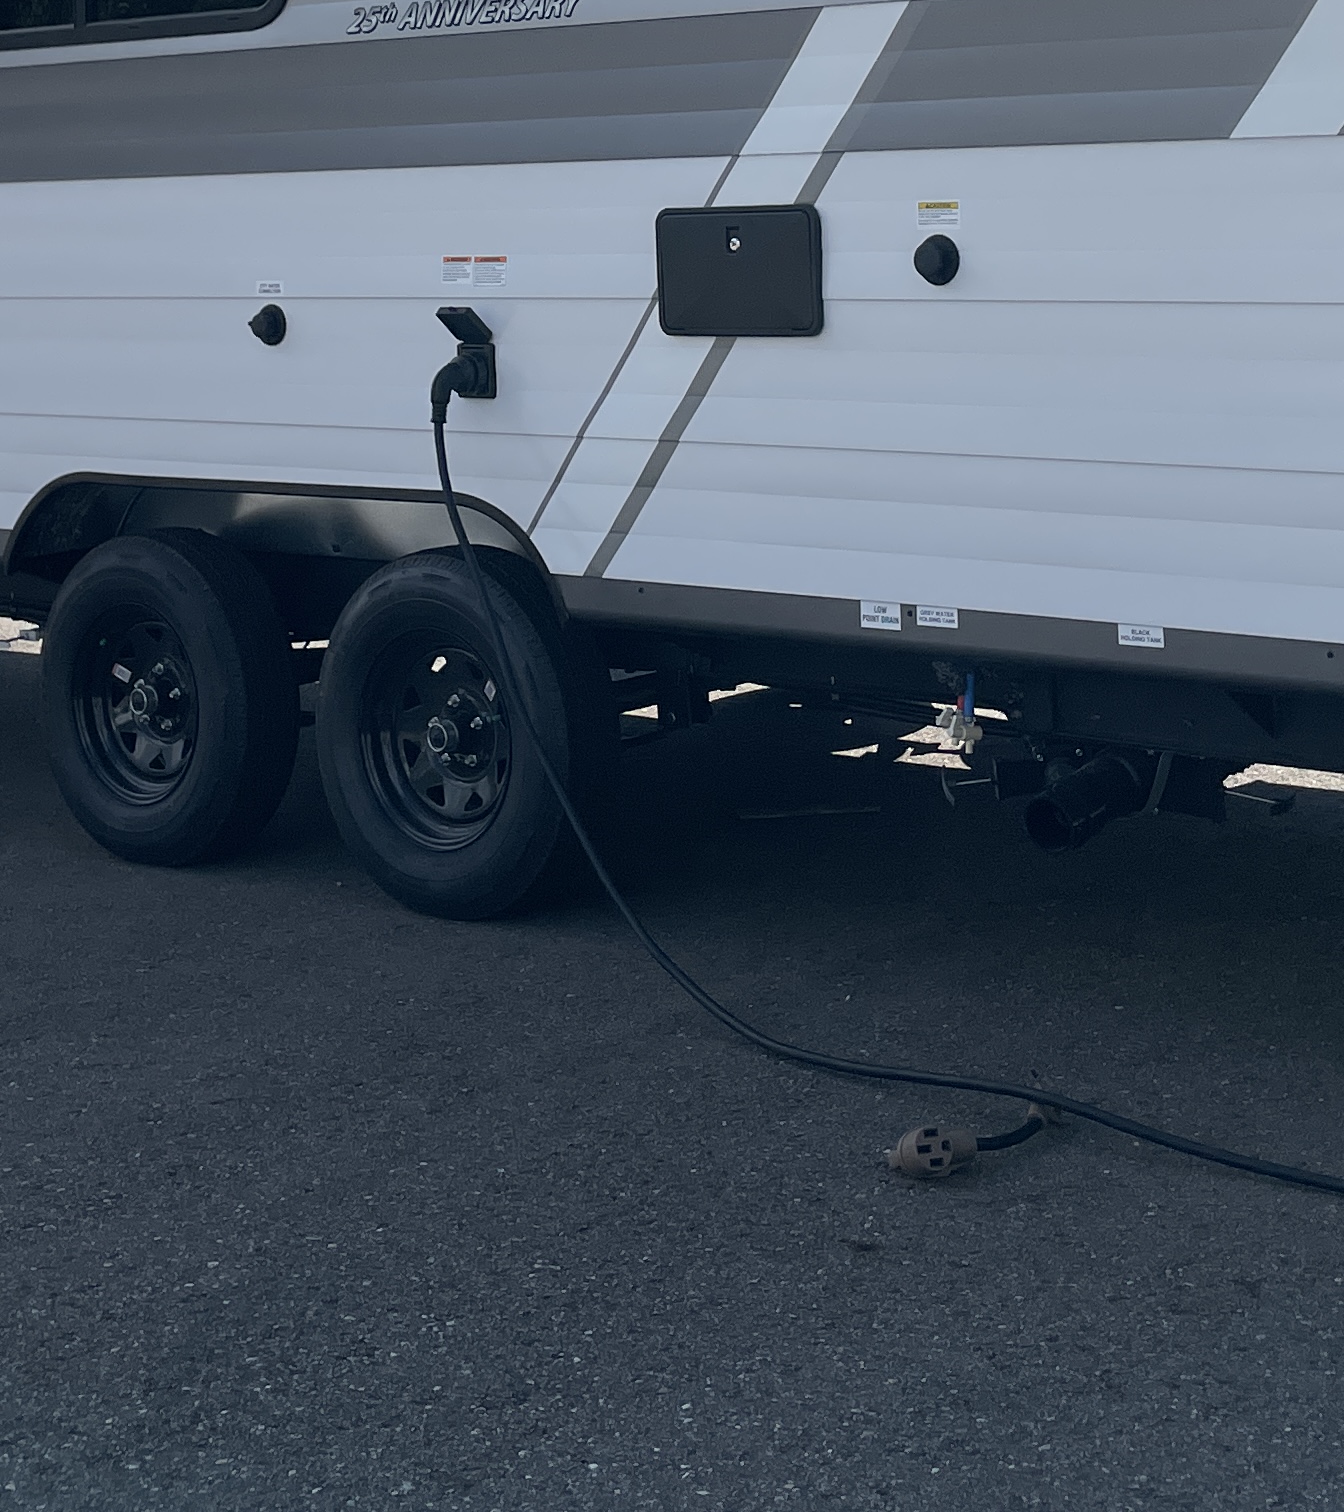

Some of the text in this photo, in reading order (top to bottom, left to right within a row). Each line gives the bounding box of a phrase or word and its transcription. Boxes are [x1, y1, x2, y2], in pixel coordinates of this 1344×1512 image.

[346, 2, 398, 35] 25th
[873, 606, 888, 614] LOW
[862, 614, 900, 624] POINT DRAIN
[1131, 628, 1151, 636] BLACK
